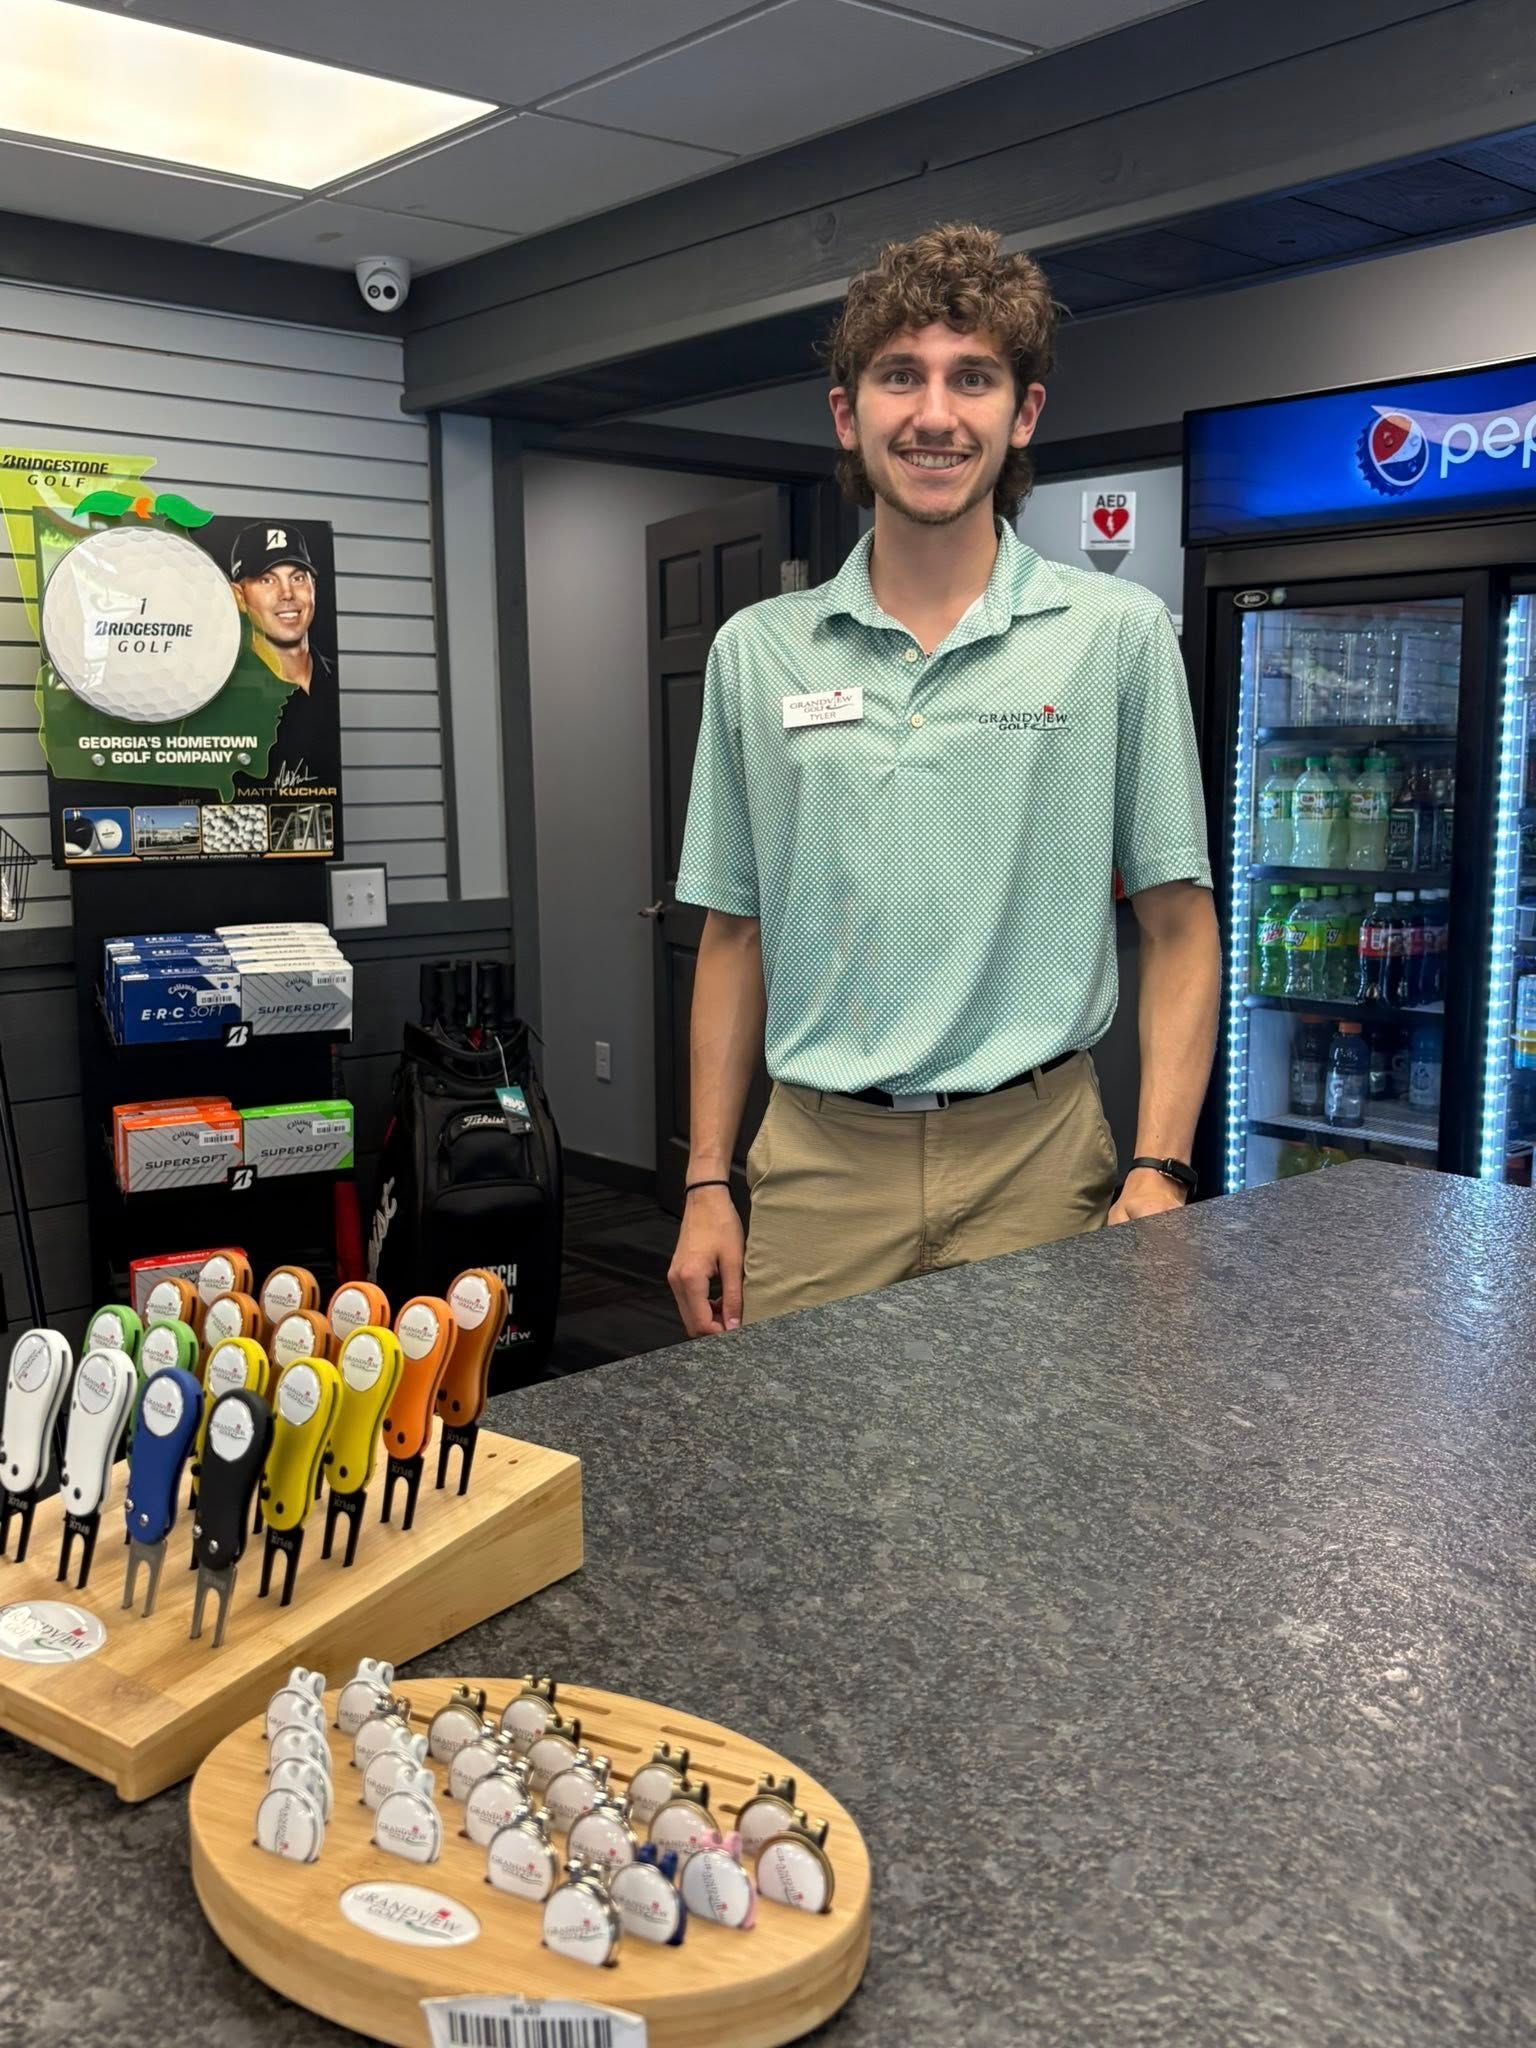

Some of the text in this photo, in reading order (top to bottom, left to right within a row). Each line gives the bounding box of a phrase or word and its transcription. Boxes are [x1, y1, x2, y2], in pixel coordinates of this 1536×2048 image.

[3, 454, 109, 474] BRIDGESTONE
[28, 474, 86, 488] GOLF
[1095, 494, 1127, 508] AED
[140, 597, 147, 615] 1
[94, 620, 193, 637] BRIDGESTONE
[118, 640, 173, 653] GOLF
[790, 695, 852, 709] GRANDVIEW
[810, 712, 836, 720] TYLER
[979, 712, 1068, 727] GRANDVIEW
[999, 723, 1029, 731] GOLF
[79, 736, 258, 749] GEORGIA'S HOMETOWN
[111, 751, 234, 764] GOLF COMPANY
[237, 787, 337, 797] MATT KUCHAR
[189, 1005, 225, 1018] SOFT
[258, 1002, 339, 1015] SUPERSOFT
[261, 1142, 340, 1158] SUPERSOFT
[145, 1153, 228, 1170] SUPERSOFT
[353, 1890, 462, 1931] GRANDVIEW
[367, 1904, 408, 1922] GOLF
